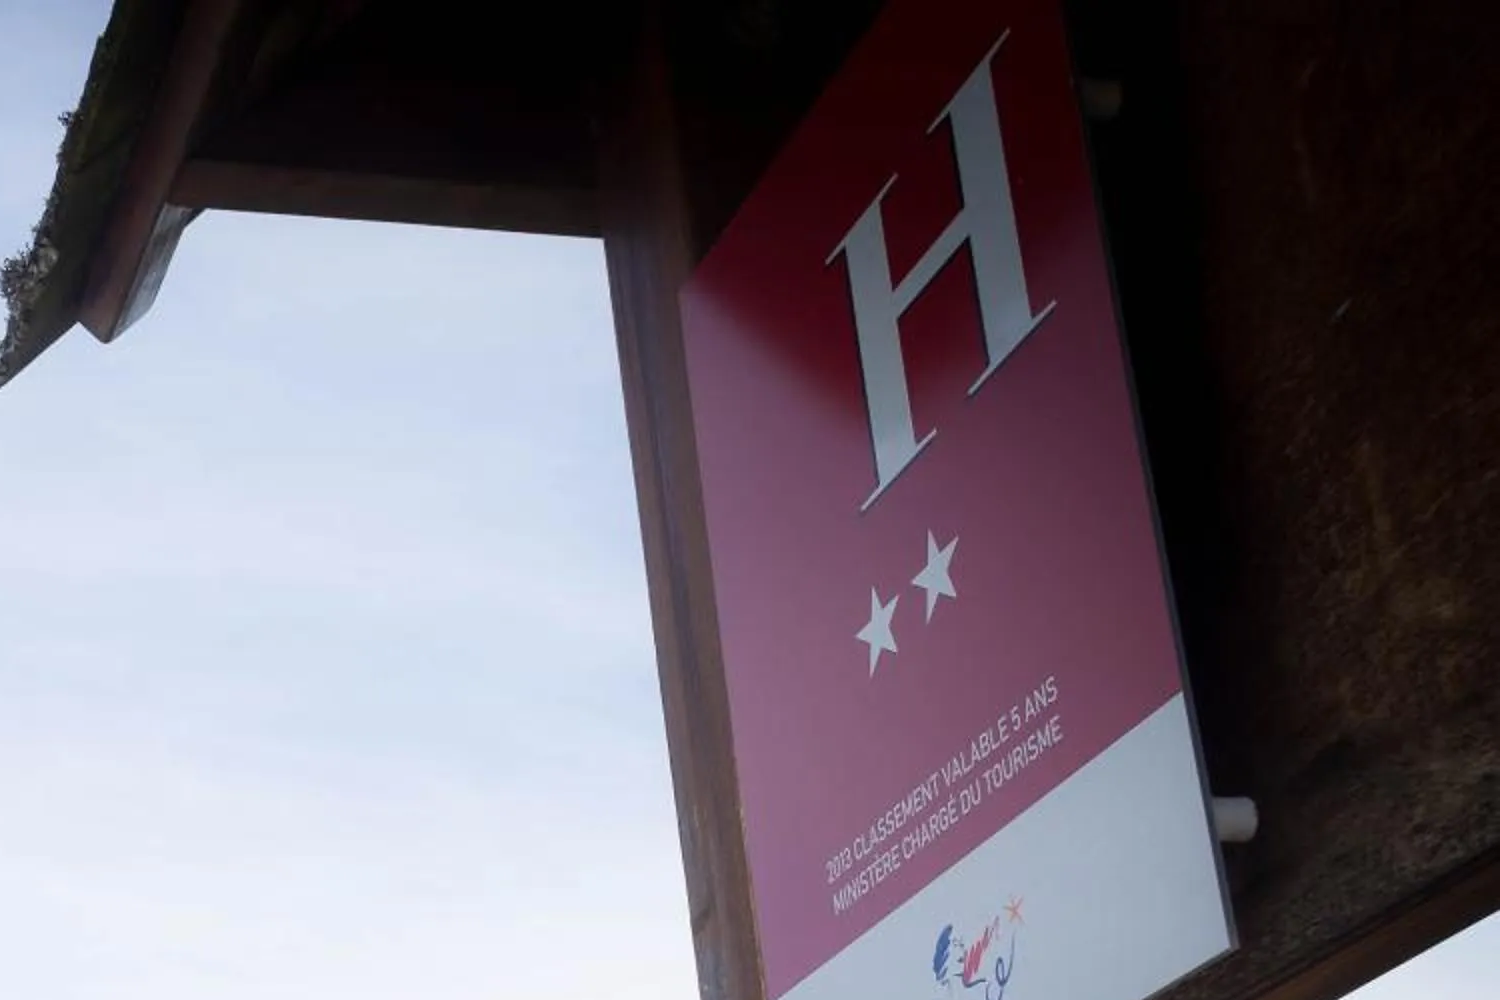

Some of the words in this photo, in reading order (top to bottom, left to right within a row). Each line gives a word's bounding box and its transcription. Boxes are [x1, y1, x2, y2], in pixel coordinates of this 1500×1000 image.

[825, 27, 1057, 513] H
[825, 847, 853, 884] 2013
[853, 772, 939, 860] CLASSEMENT
[941, 715, 1010, 786] VALABLE
[1011, 705, 1021, 731] 5
[1025, 675, 1058, 722] ANS
[833, 844, 901, 915] MINISTÈRE
[901, 793, 959, 860] CHARGÉ
[959, 779, 981, 816] DU
[982, 715, 1064, 794] TOURISME
